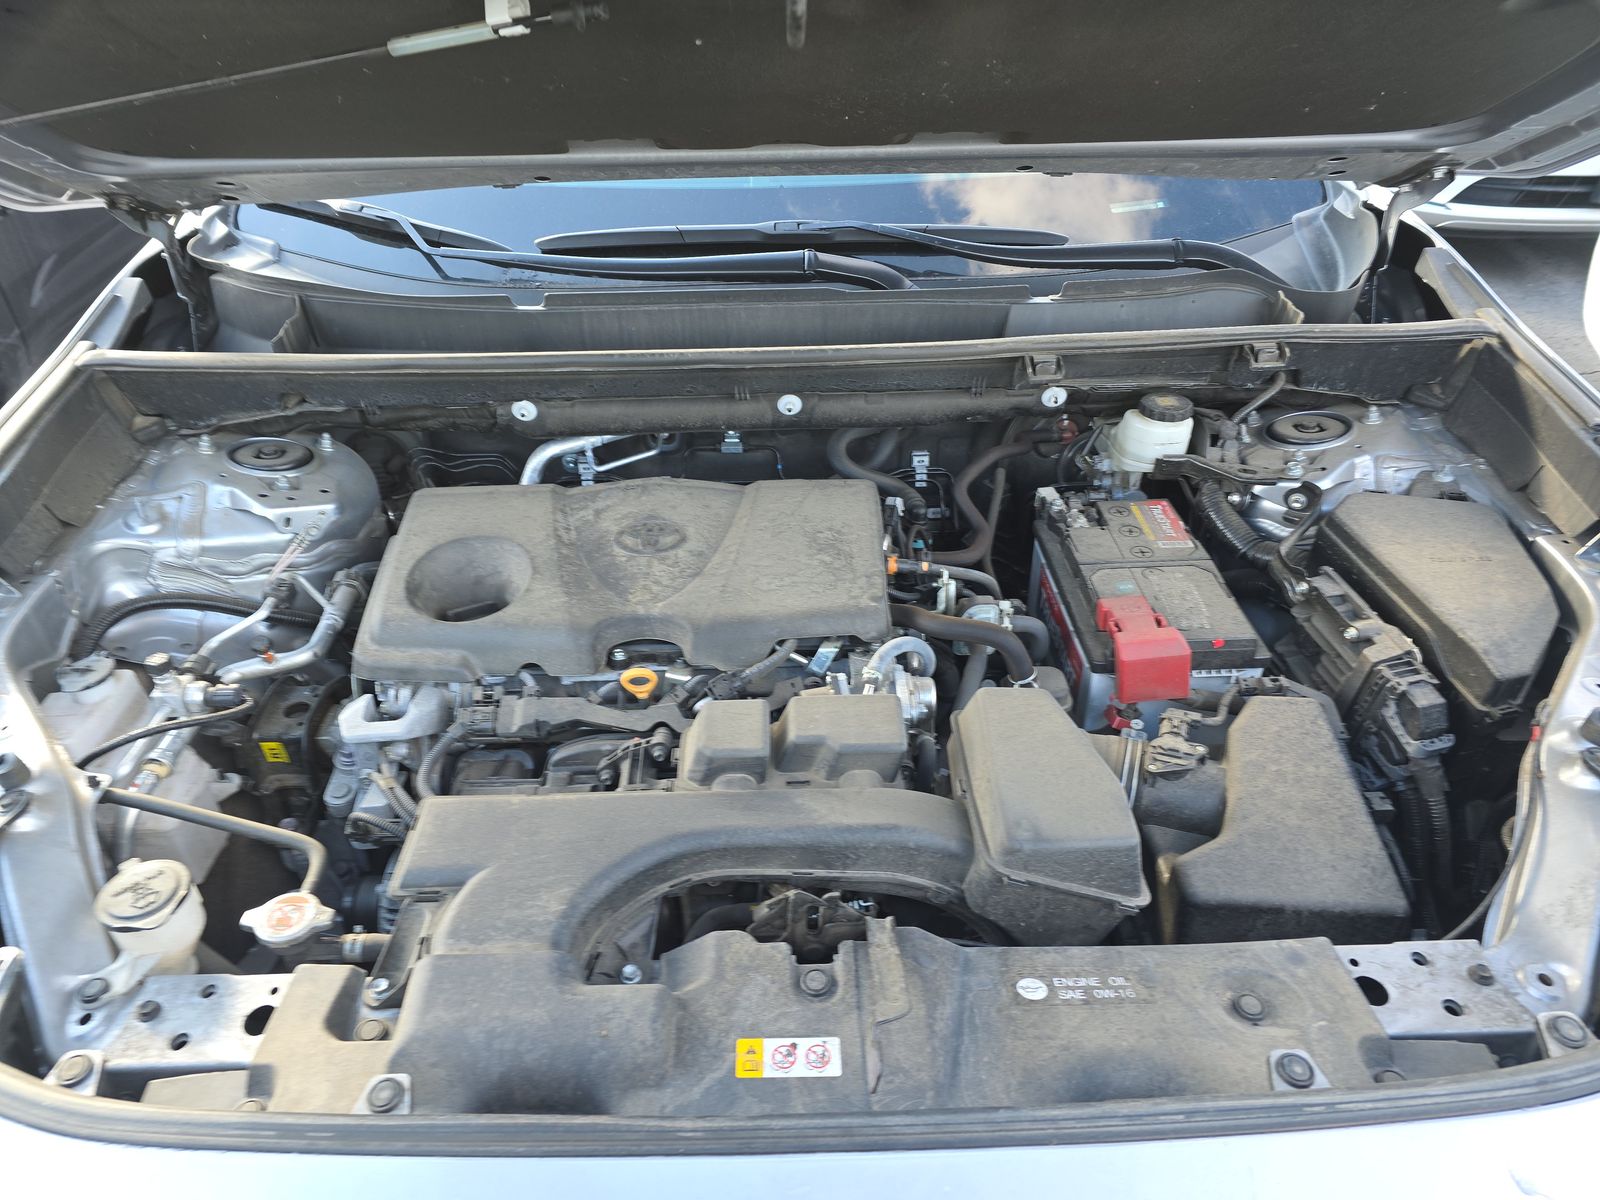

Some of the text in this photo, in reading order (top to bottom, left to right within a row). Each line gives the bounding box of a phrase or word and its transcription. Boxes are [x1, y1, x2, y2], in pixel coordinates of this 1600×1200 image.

[1052, 976, 1131, 987] ENGINE OIL
[1058, 989, 1136, 999] SAE 0W-16
